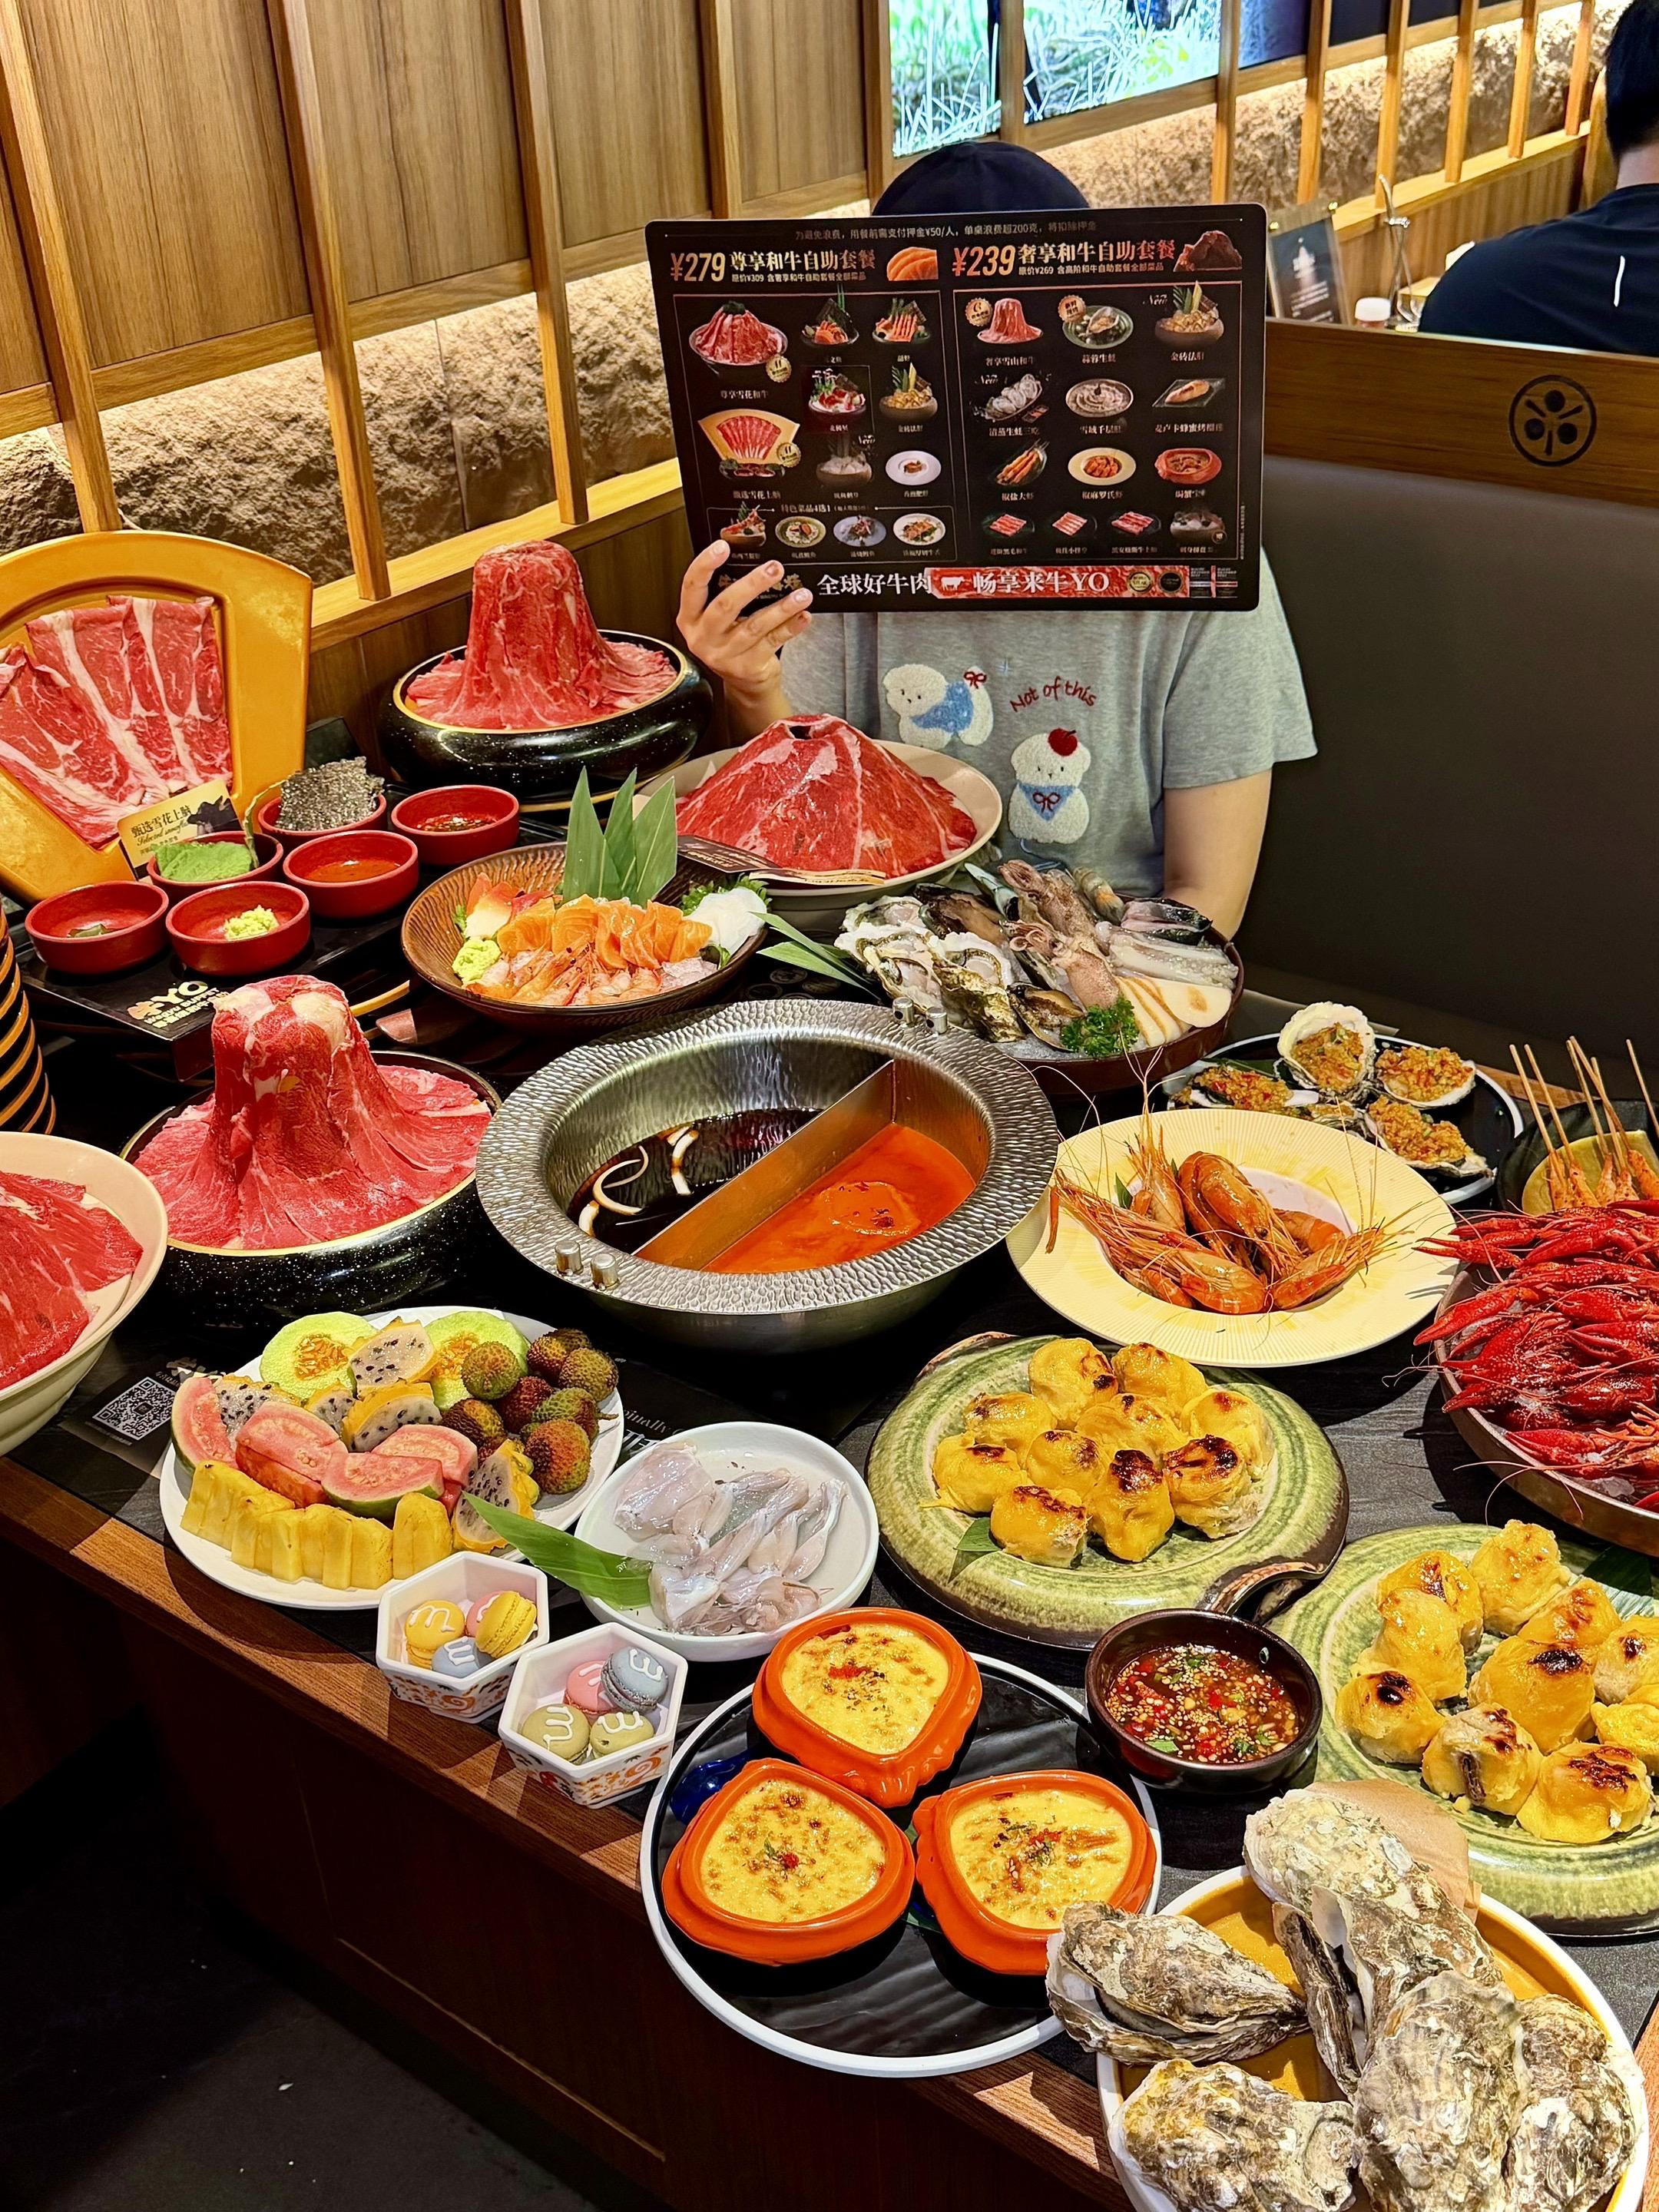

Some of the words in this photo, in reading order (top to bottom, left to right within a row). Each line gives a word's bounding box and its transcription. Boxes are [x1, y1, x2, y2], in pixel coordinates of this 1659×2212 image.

[671, 252, 726, 282] ¥279
[730, 249, 876, 272] 尊享和牛自助套餐
[952, 245, 1017, 276] ¥239
[1018, 239, 1176, 264] 奢享和牛自助套餐
[1018, 265, 1054, 275] 原价¥269
[816, 572, 932, 596] 全球好牛肉
[972, 570, 1110, 595] 畅享来牛YO
[1010, 687, 1039, 713] Not
[1043, 675, 1062, 701] of
[1065, 680, 1097, 707] this
[131, 805, 192, 839] 甄选雪花上脑
